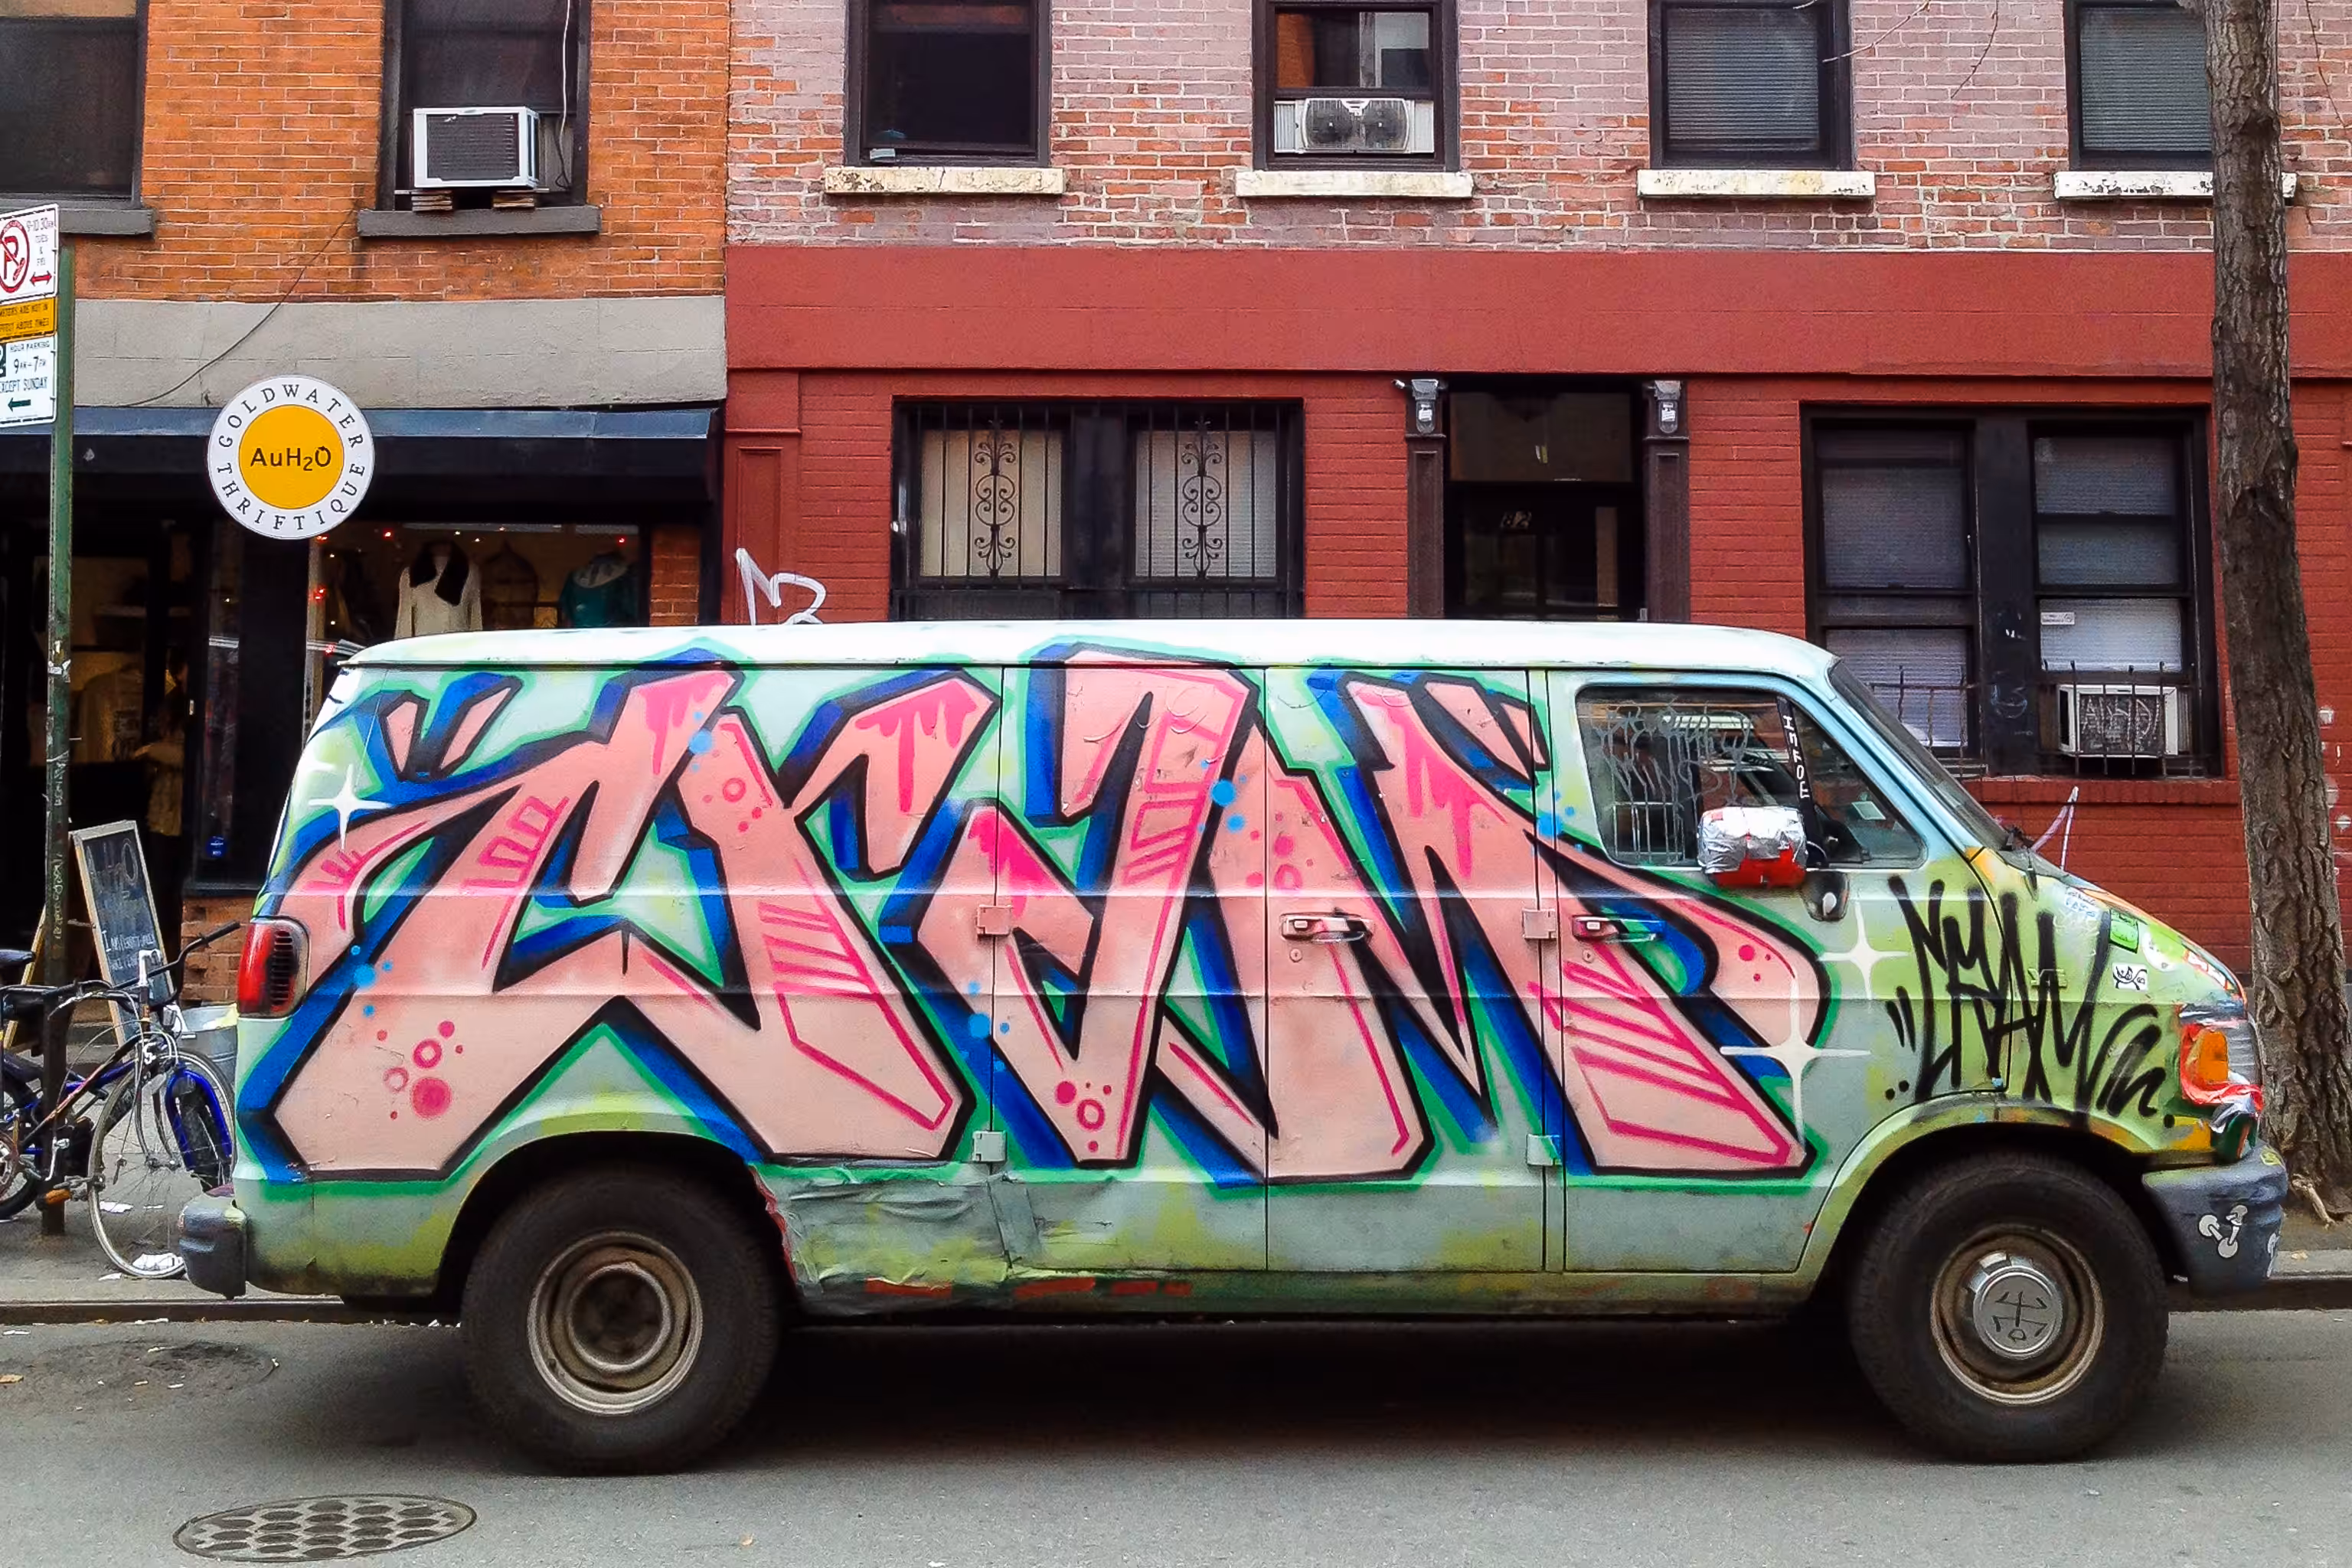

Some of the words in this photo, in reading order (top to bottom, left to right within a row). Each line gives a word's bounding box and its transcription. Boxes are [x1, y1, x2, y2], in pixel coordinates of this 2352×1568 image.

[24, 376, 47, 391] SUNDAY
[218, 384, 364, 449] GOLDWATER
[217, 462, 365, 531] THRIFTIQUE
